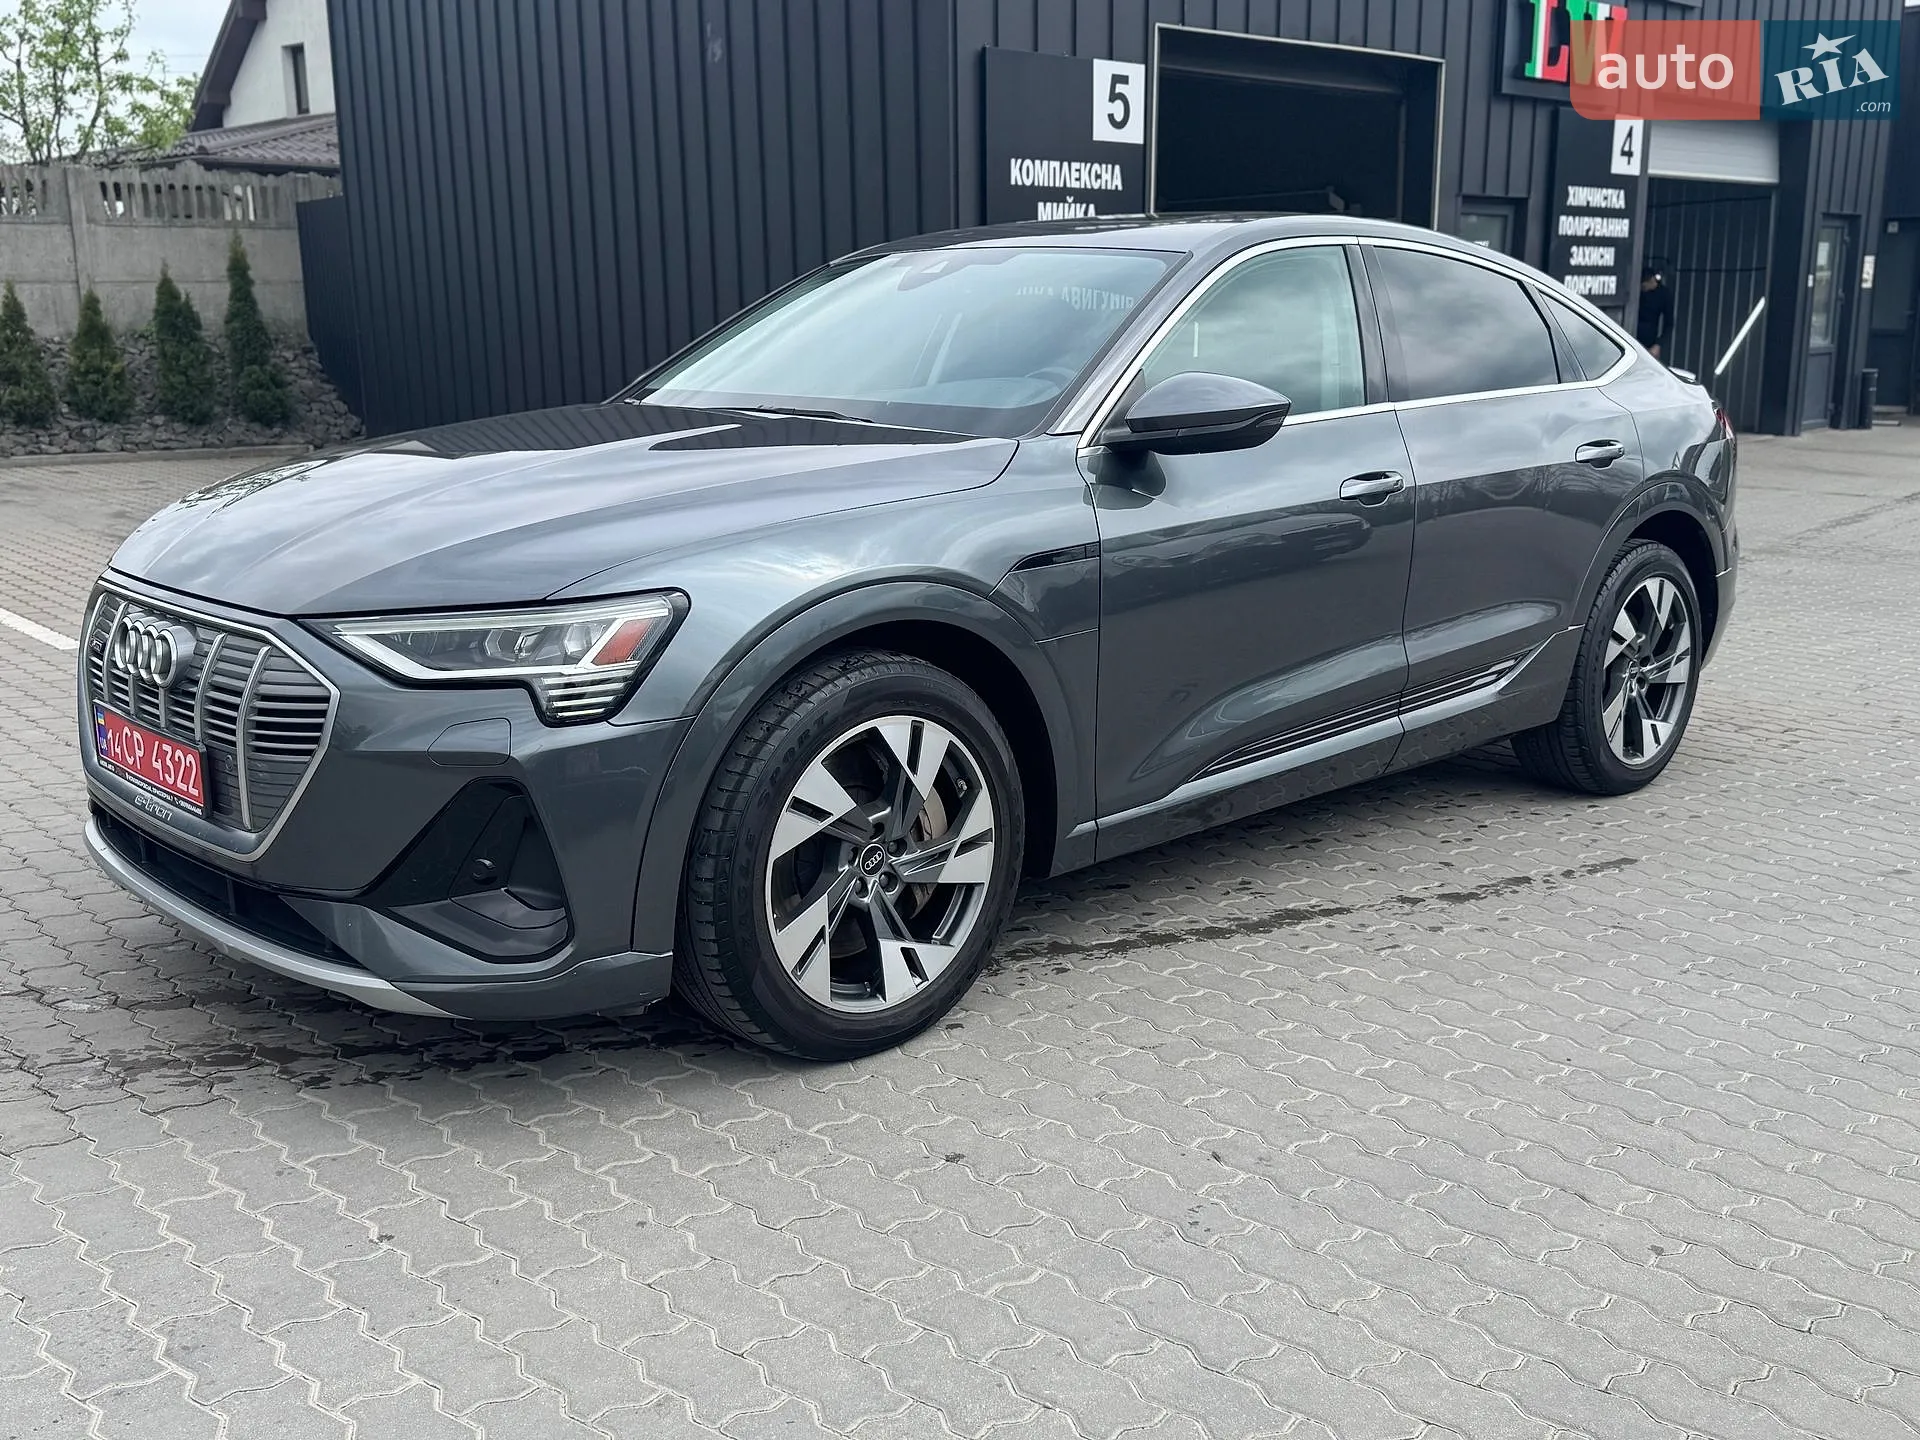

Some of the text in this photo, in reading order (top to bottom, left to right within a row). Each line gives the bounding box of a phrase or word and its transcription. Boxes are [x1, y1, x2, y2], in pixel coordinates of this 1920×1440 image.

[1107, 74, 1130, 130] 5
[1620, 125, 1634, 165] 4
[1010, 158, 1123, 191] КОМПЛЕКСНА
[1566, 185, 1626, 209] ХІМЧИСТКА
[1558, 215, 1630, 238] ПОЛІРУВАННЯ
[1569, 245, 1615, 267] ЗАХИСНІ
[1564, 275, 1617, 295] ПОКРИТТЯ
[152, 740, 199, 797] 4322
